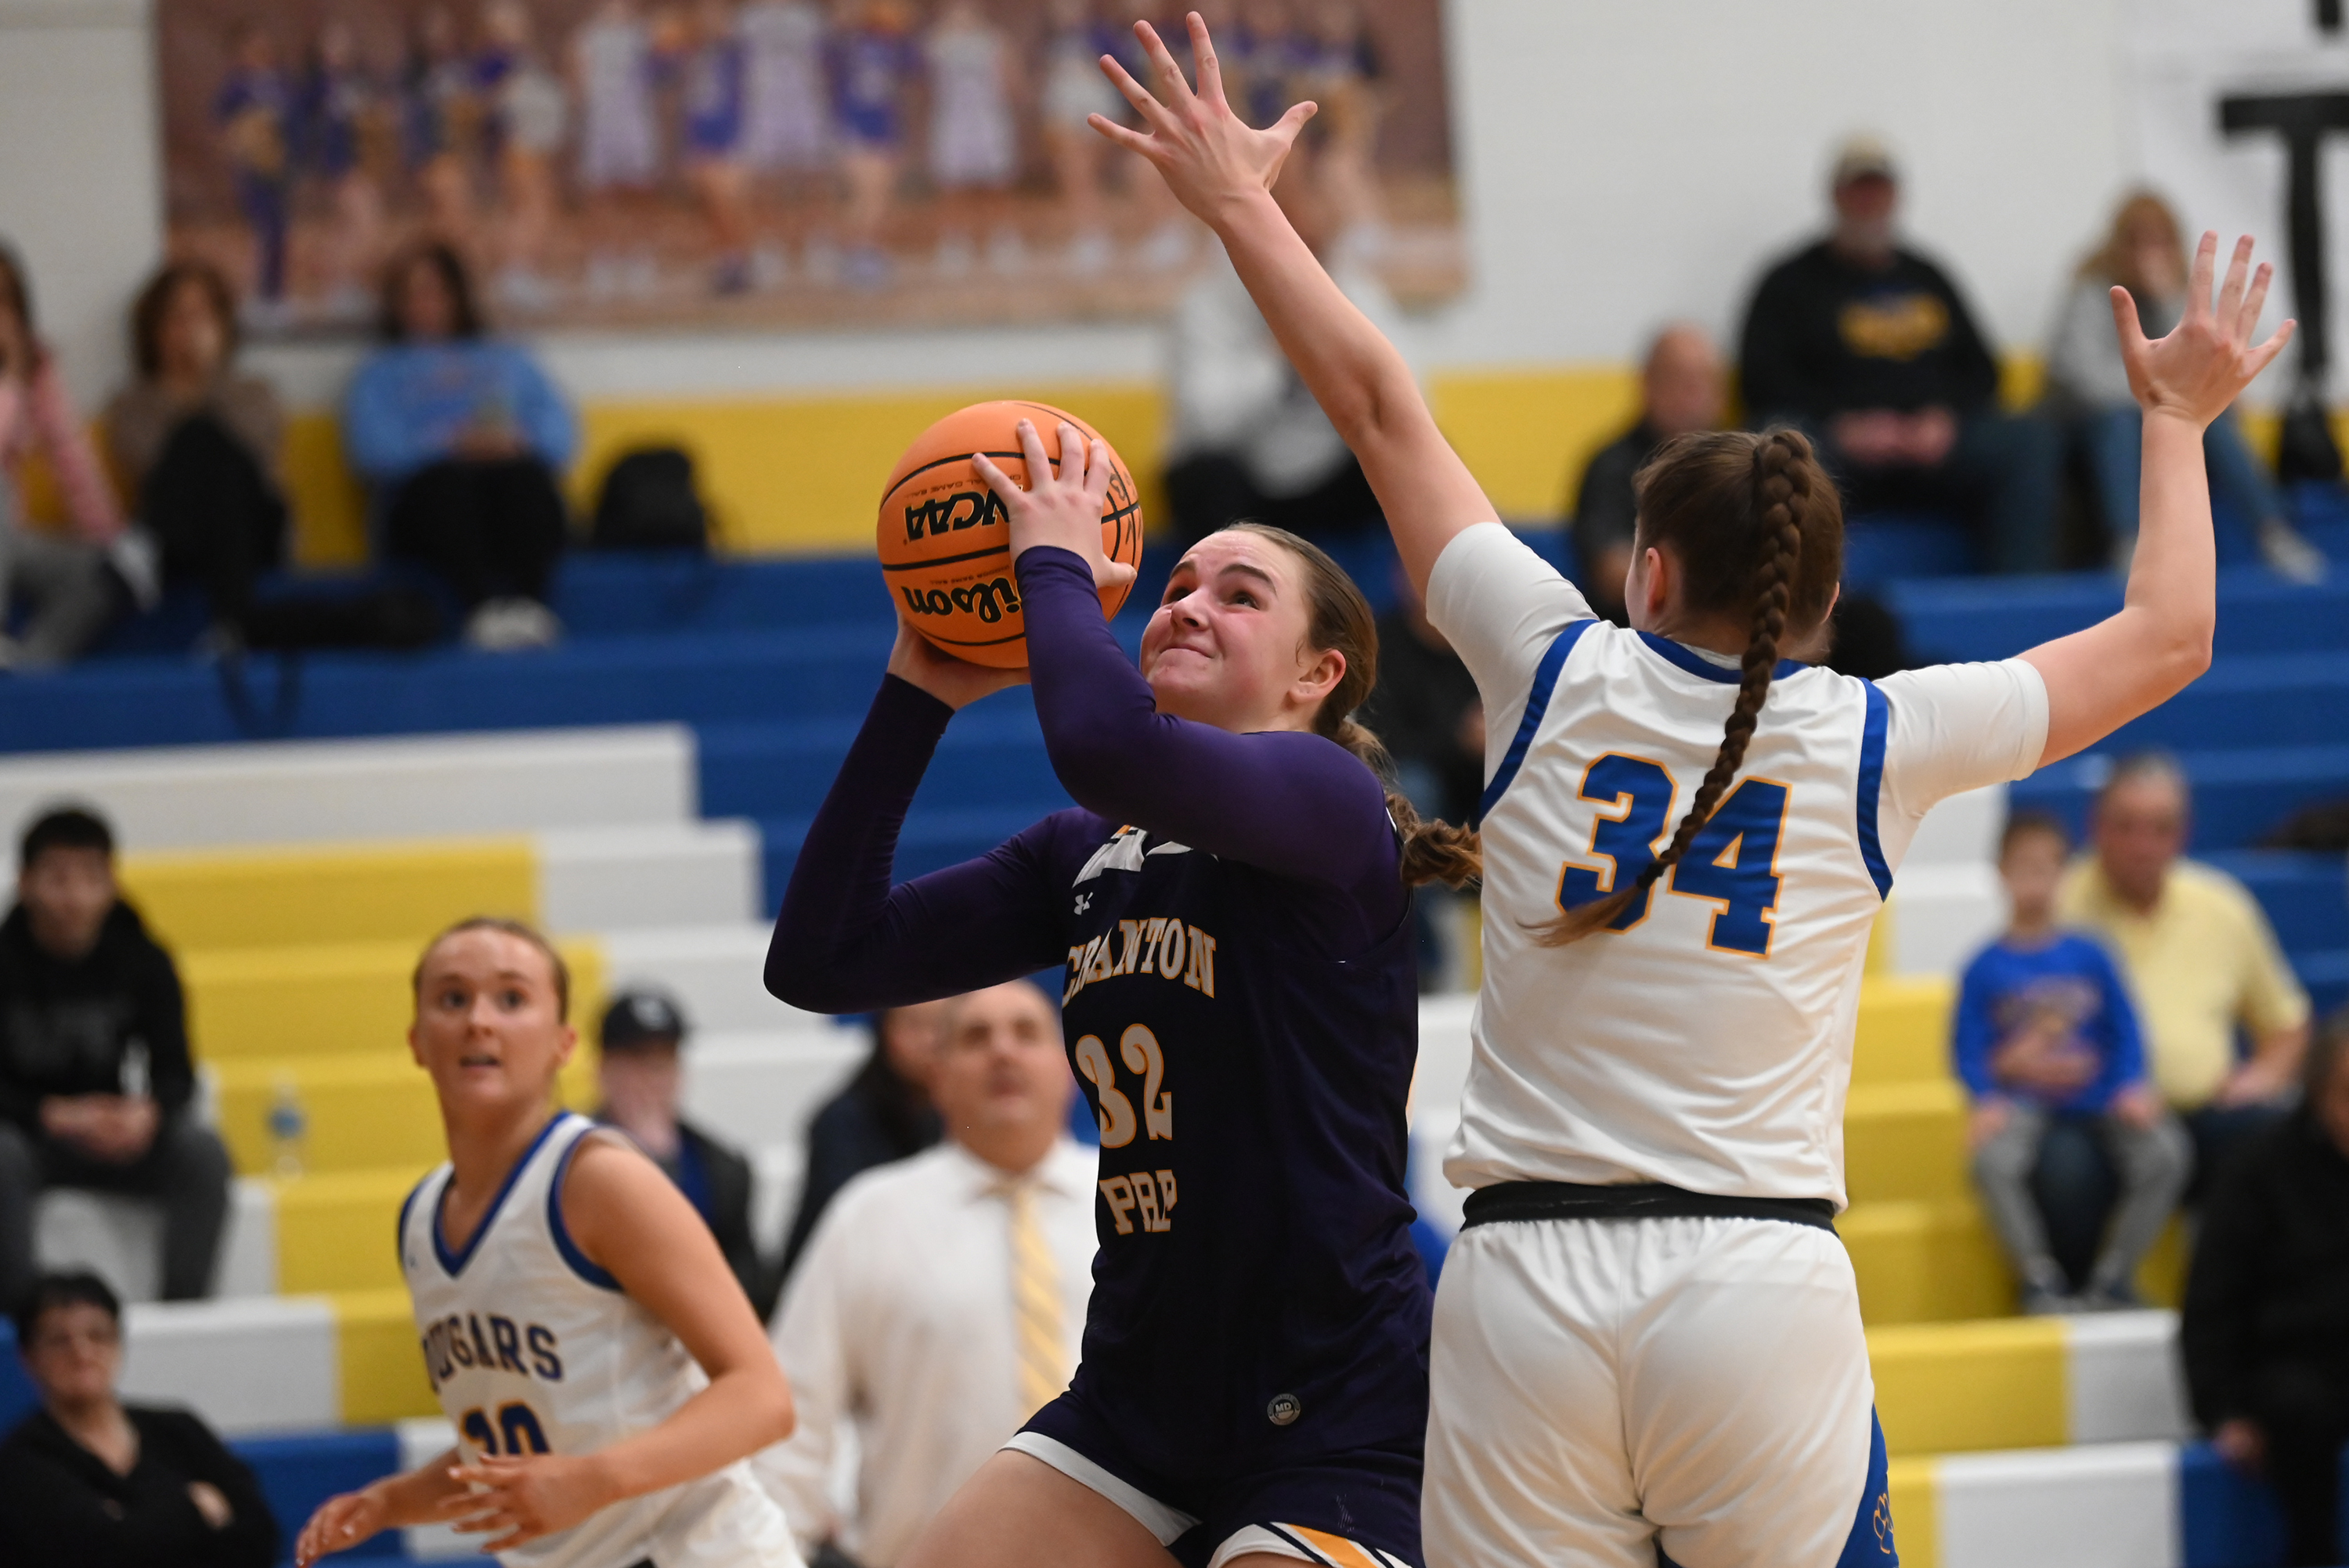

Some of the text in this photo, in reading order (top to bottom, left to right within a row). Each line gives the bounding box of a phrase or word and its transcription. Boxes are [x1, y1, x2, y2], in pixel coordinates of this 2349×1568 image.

[900, 576, 1022, 624] ilson
[1554, 751, 1792, 960] 34
[1075, 1023, 1173, 1148] 32
[1275, 1402, 1292, 1412] MD
